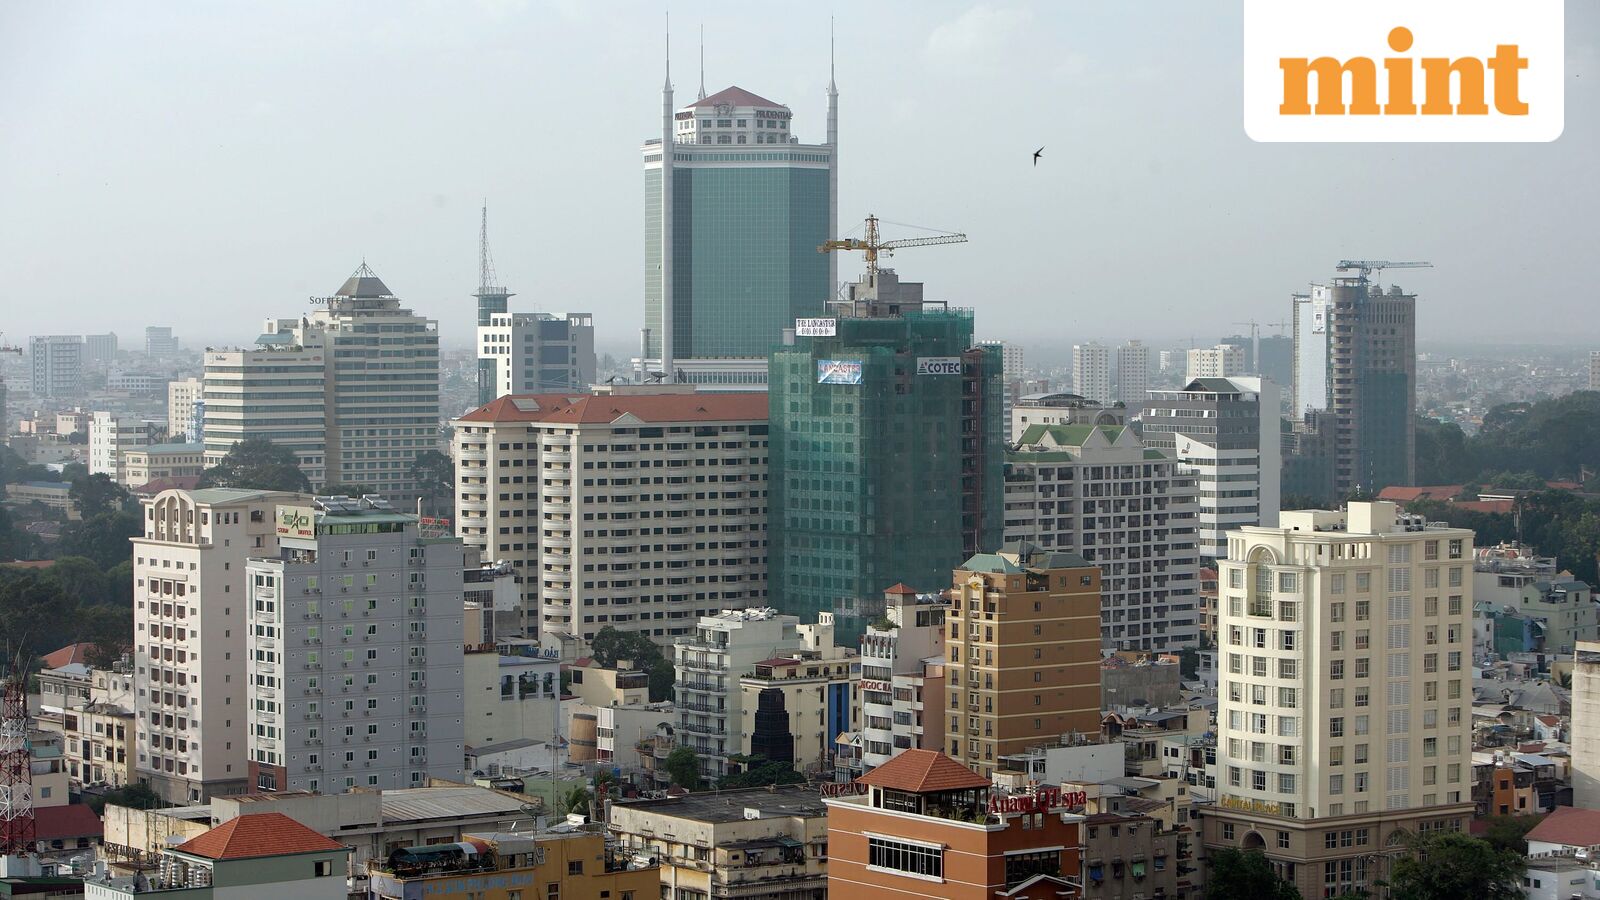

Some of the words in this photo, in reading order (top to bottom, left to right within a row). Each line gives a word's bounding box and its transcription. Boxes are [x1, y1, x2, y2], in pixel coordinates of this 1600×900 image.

[756, 110, 793, 120] PRUDENTIAL
[797, 319, 807, 328] THE
[808, 319, 835, 328] LANCASTER
[928, 363, 960, 373] COTEC
[1061, 790, 1087, 810] spa
